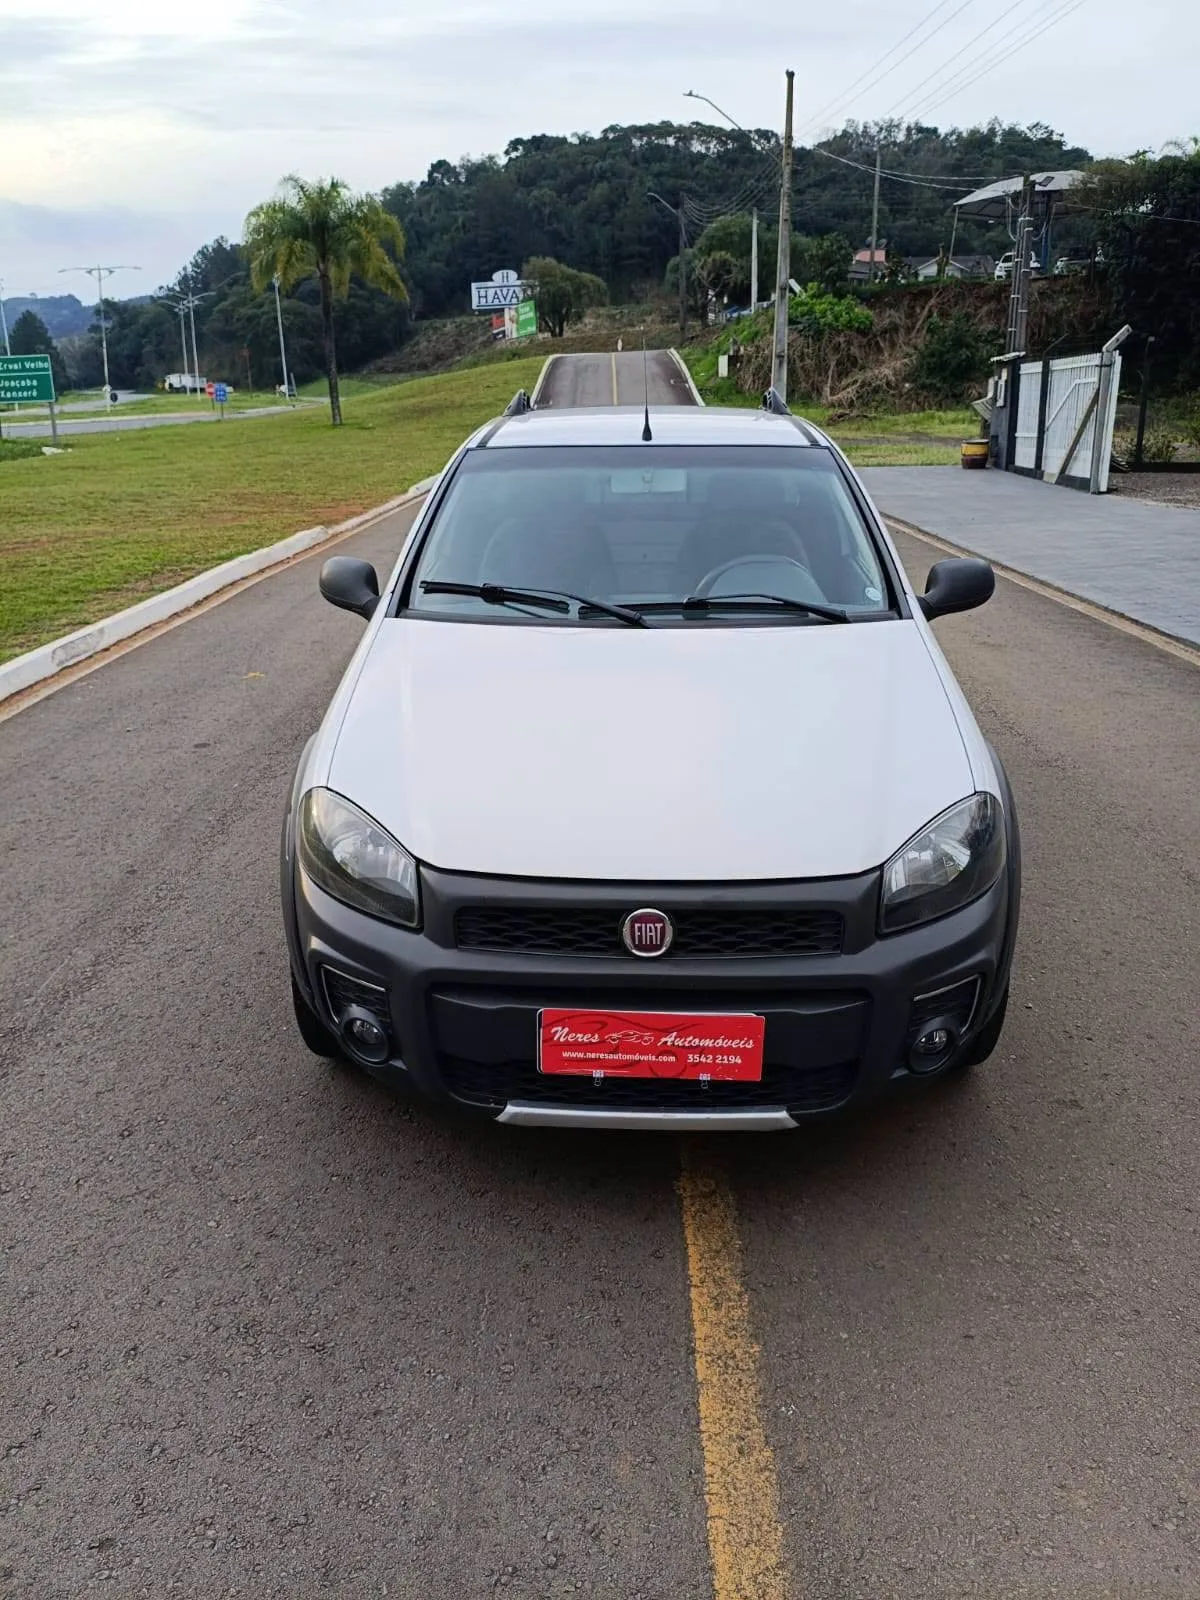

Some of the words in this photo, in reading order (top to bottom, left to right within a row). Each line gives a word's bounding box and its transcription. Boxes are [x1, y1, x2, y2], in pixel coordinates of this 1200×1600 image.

[501, 271, 509, 283] H
[24, 361, 49, 369] Velho
[634, 923, 664, 945] FIAT
[550, 1026, 600, 1043] Neres
[657, 1031, 755, 1049] Automóveis
[562, 1050, 676, 1063] www.neresautomóveis.com
[687, 1053, 713, 1064] 3542
[715, 1055, 742, 1065] 2194
